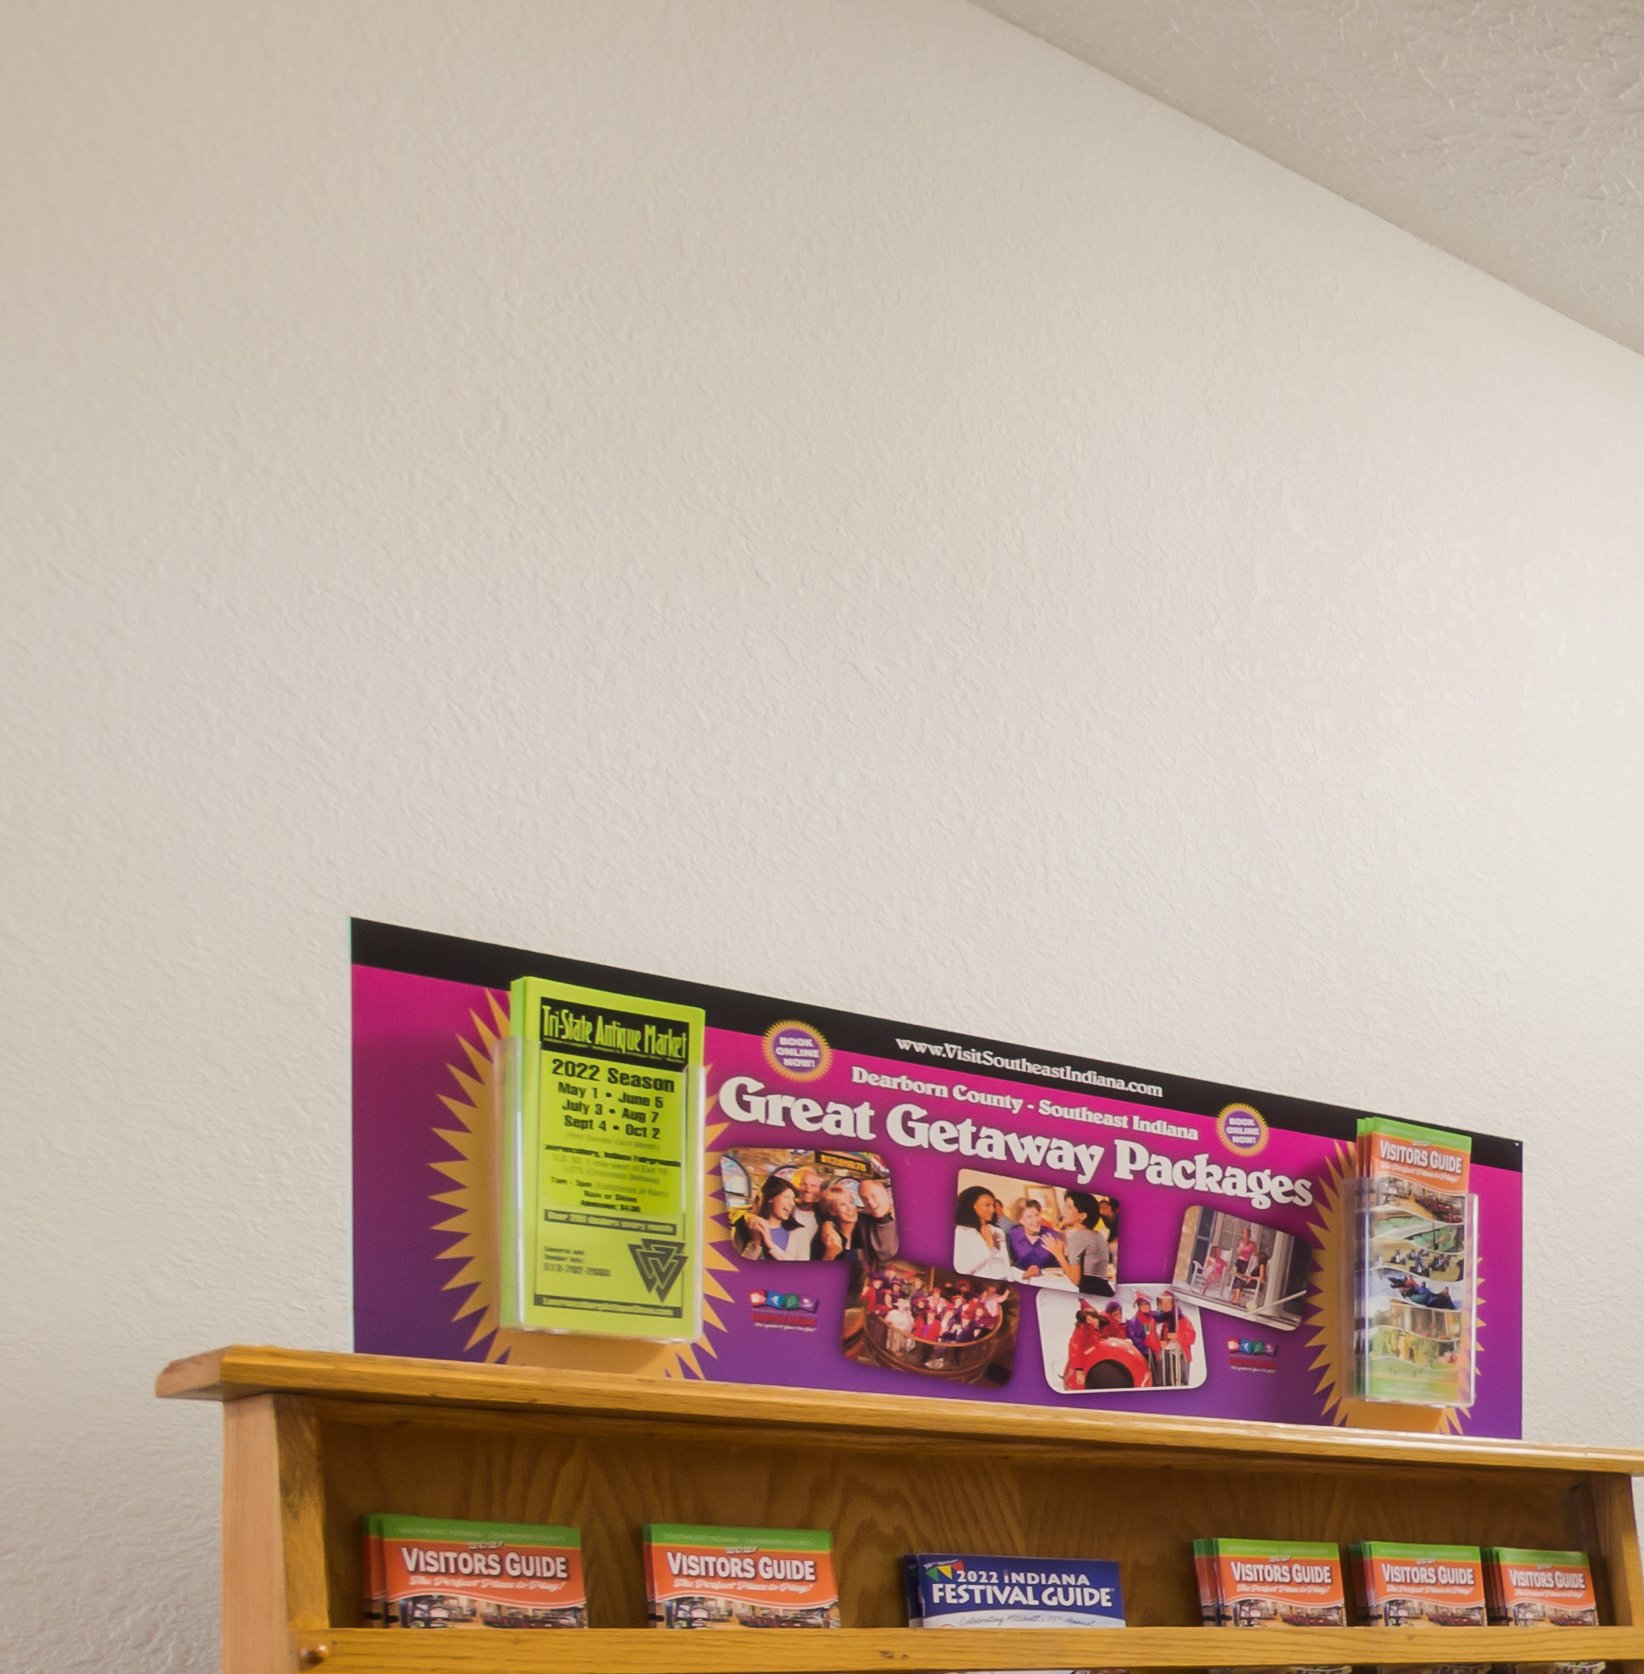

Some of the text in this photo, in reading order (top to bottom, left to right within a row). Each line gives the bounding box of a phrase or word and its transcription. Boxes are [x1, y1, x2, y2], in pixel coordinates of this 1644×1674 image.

[542, 1005, 687, 1058] Tri-State Antique Market
[779, 1036, 814, 1049] BOOK
[775, 1046, 820, 1060] ONLINE
[783, 1056, 816, 1068] NOW!
[552, 1058, 675, 1093] 2022 Season
[895, 1037, 1163, 1098] www.VisitSoutheastIndiana.com
[558, 1082, 586, 1099] May
[593, 1087, 598, 1099] 1
[618, 1092, 650, 1107] June
[851, 1066, 1199, 1141] Dearborn County Southeast Indiana
[562, 1100, 659, 1123] July 3 Aug 7
[1228, 1117, 1255, 1128] BOOK
[564, 1115, 660, 1139] Sept 4 Oct 2
[1226, 1126, 1260, 1137] ONLINE
[718, 1075, 1314, 1210] Great Getaway Packages
[1380, 1140, 1462, 1173] VISITORS GUIDE
[401, 1547, 568, 1579] VISITORS GUIDE
[666, 1551, 816, 1581] VISITORS GUIDE
[1230, 1561, 1332, 1584] VISITORS GUIDE
[1381, 1562, 1475, 1586] VISITORS GUIDE
[956, 1570, 999, 1583] 2022
[1508, 1568, 1586, 1590] VISITORS GUIDE
[932, 1583, 1113, 1607] FESTIVAL GUIDE
